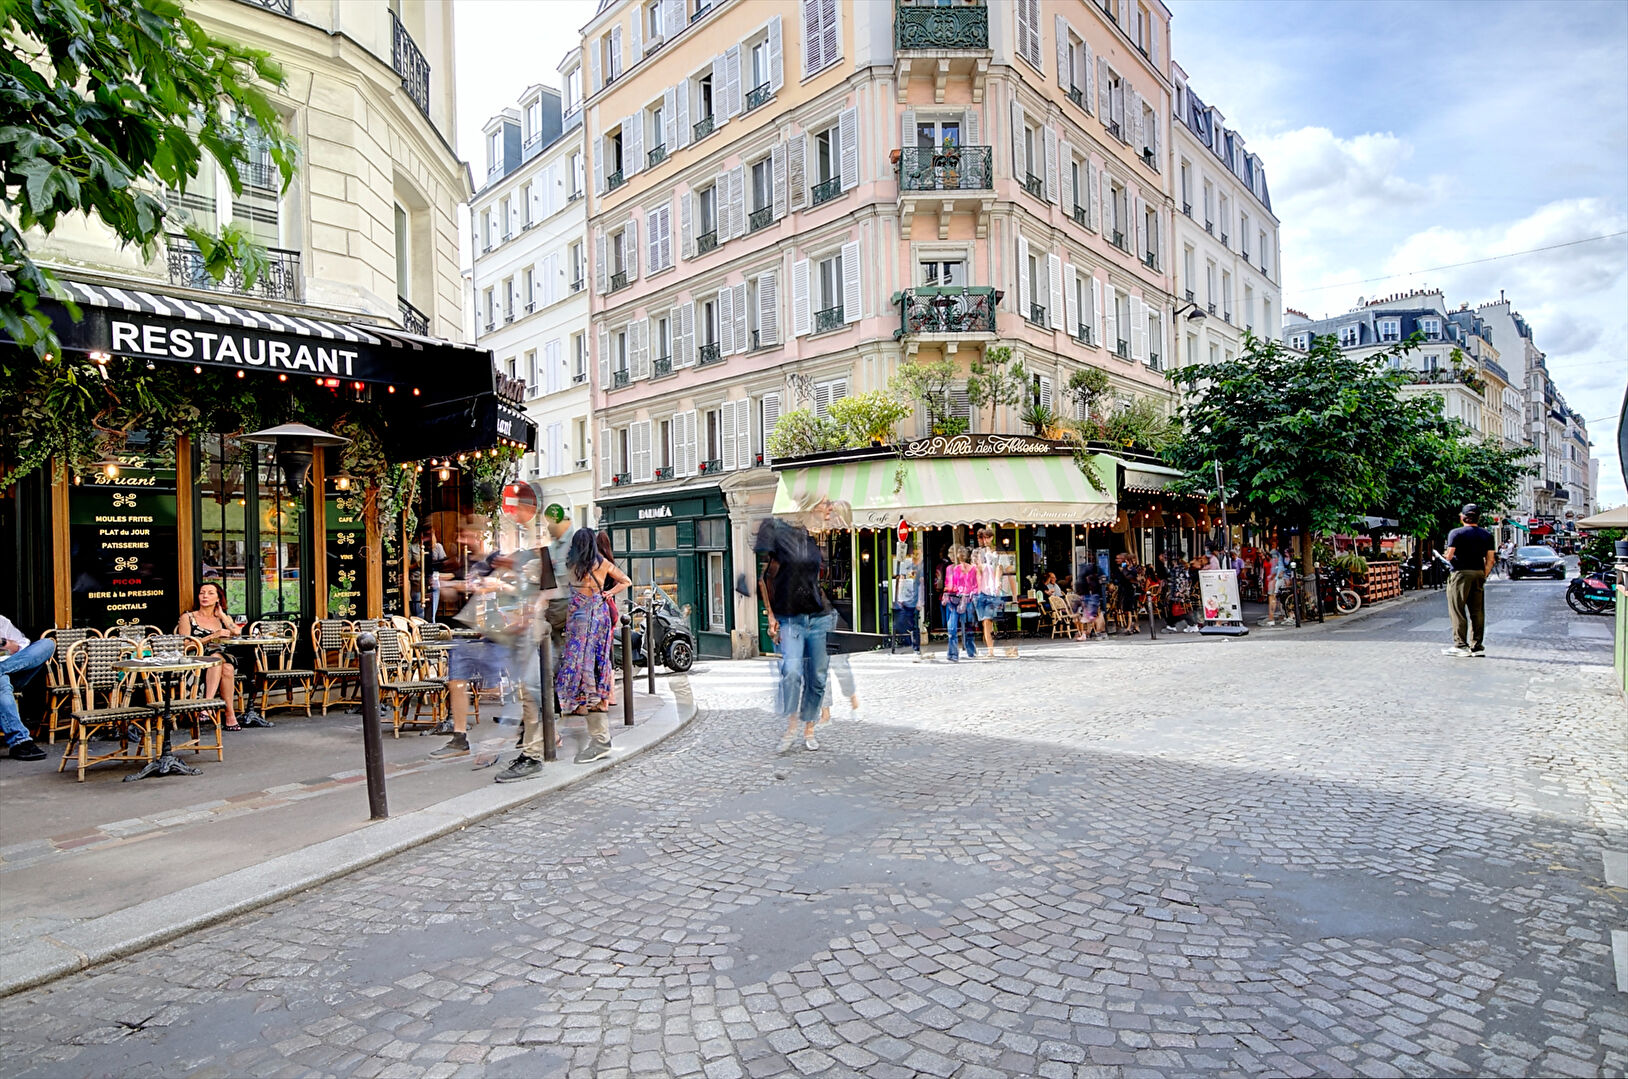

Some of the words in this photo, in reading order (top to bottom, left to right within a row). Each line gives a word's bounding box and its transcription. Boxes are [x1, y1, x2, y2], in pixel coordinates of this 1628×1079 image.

[111, 321, 358, 376] RESTAURANT
[904, 440, 937, 456] La
[932, 435, 973, 455] Villa
[974, 440, 993, 454] des
[988, 435, 1050, 454] Abbesses
[94, 472, 156, 486] Bruant
[127, 589, 164, 597] PRESSION
[106, 602, 148, 611] COCKTAILS
